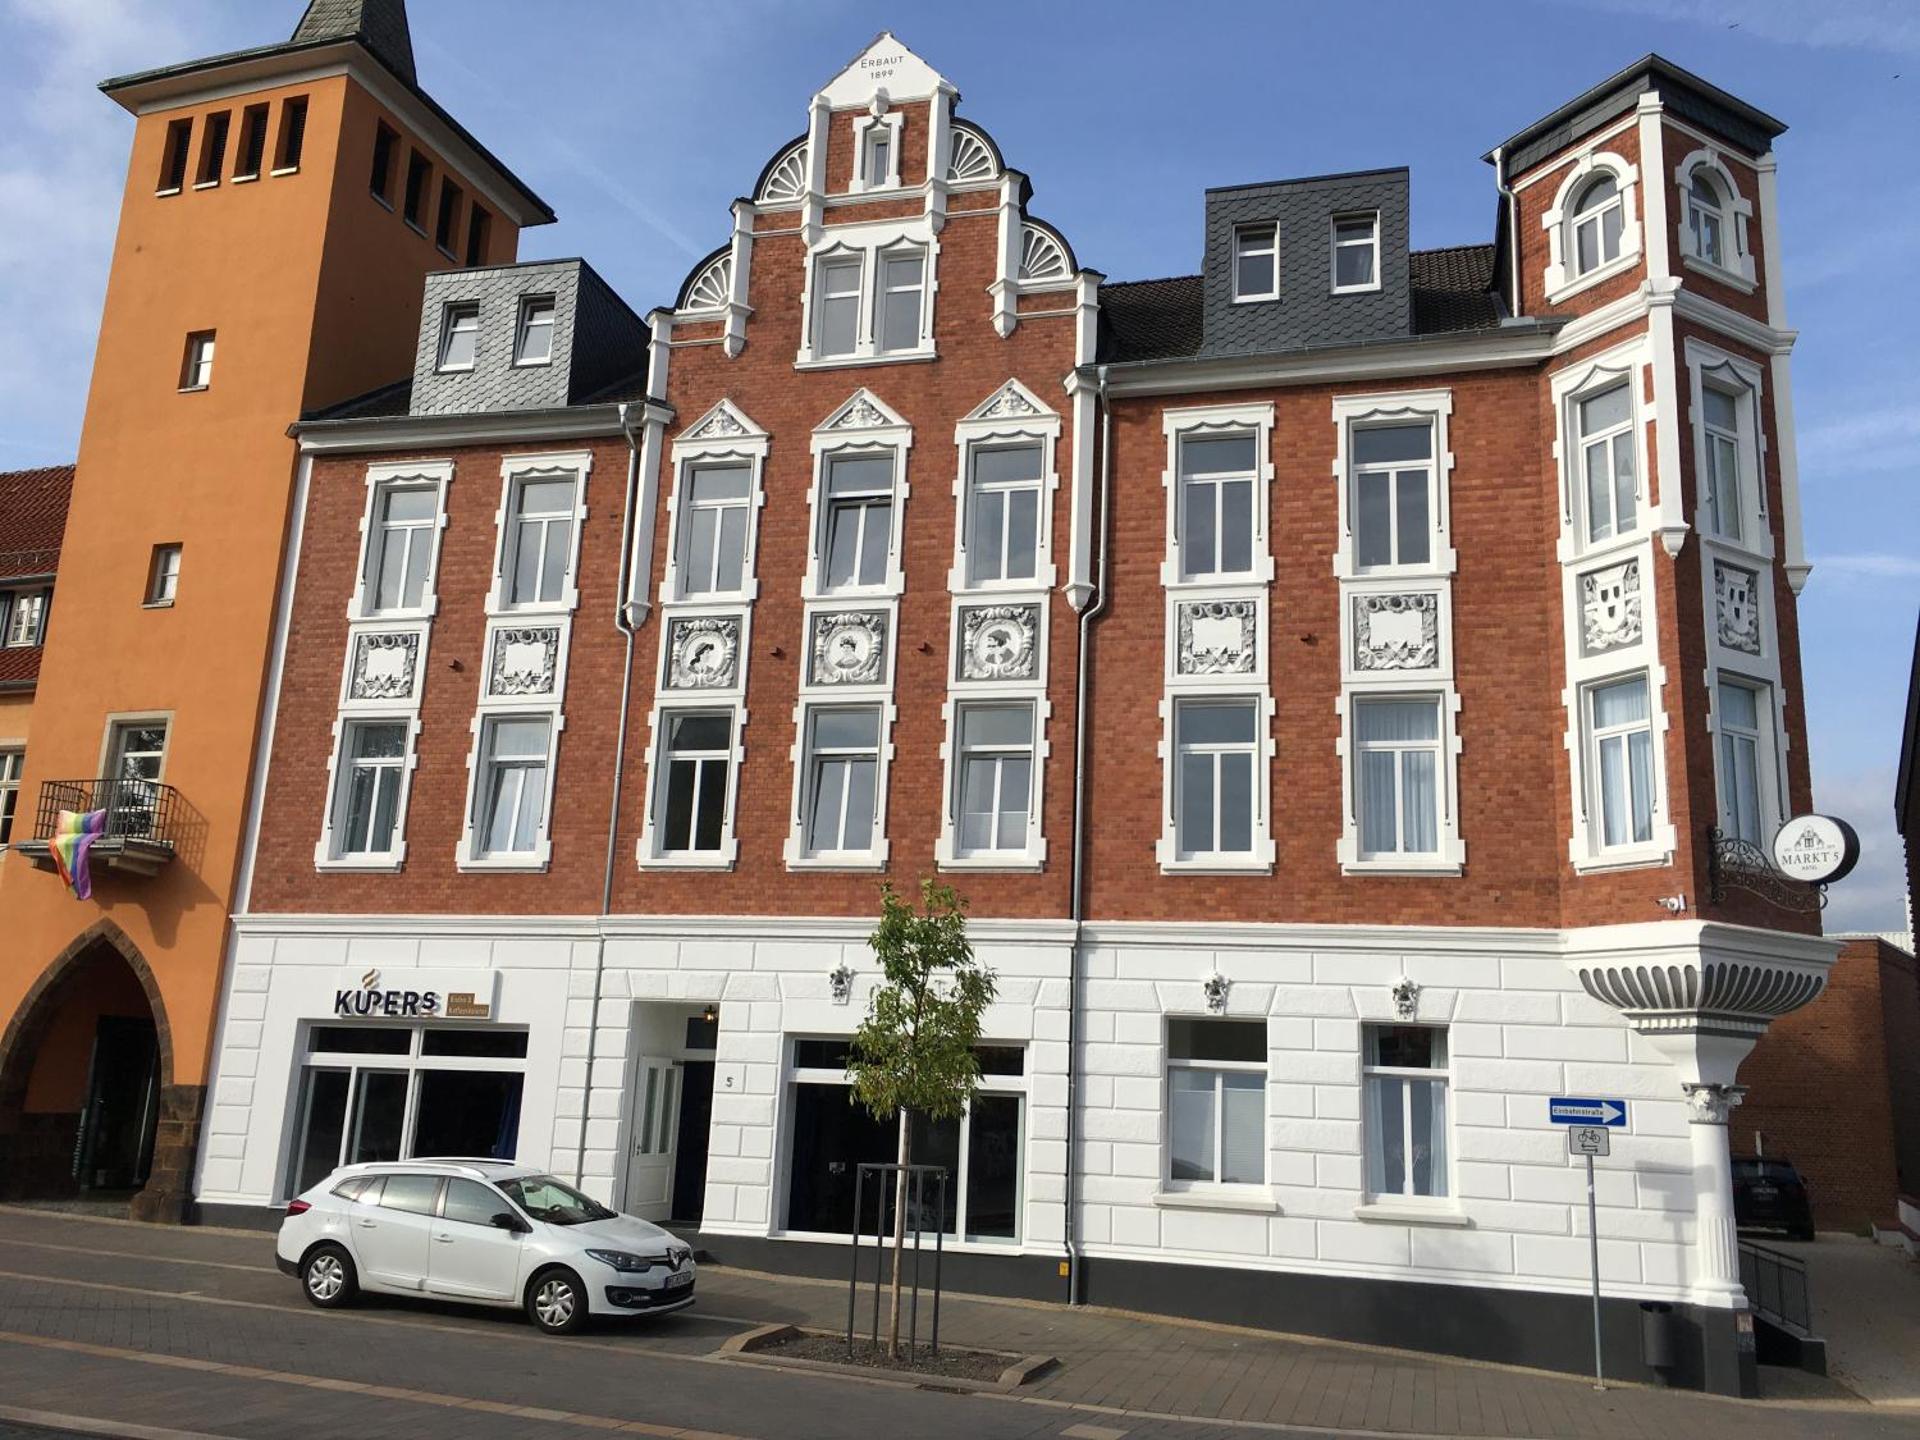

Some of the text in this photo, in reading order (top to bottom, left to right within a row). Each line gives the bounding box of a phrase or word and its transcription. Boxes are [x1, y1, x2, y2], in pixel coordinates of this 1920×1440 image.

[861, 56, 904, 69] ERBAUT
[871, 69, 894, 79] 1899
[1781, 852, 1840, 865] MARKT 5
[726, 1076, 735, 1088] 5
